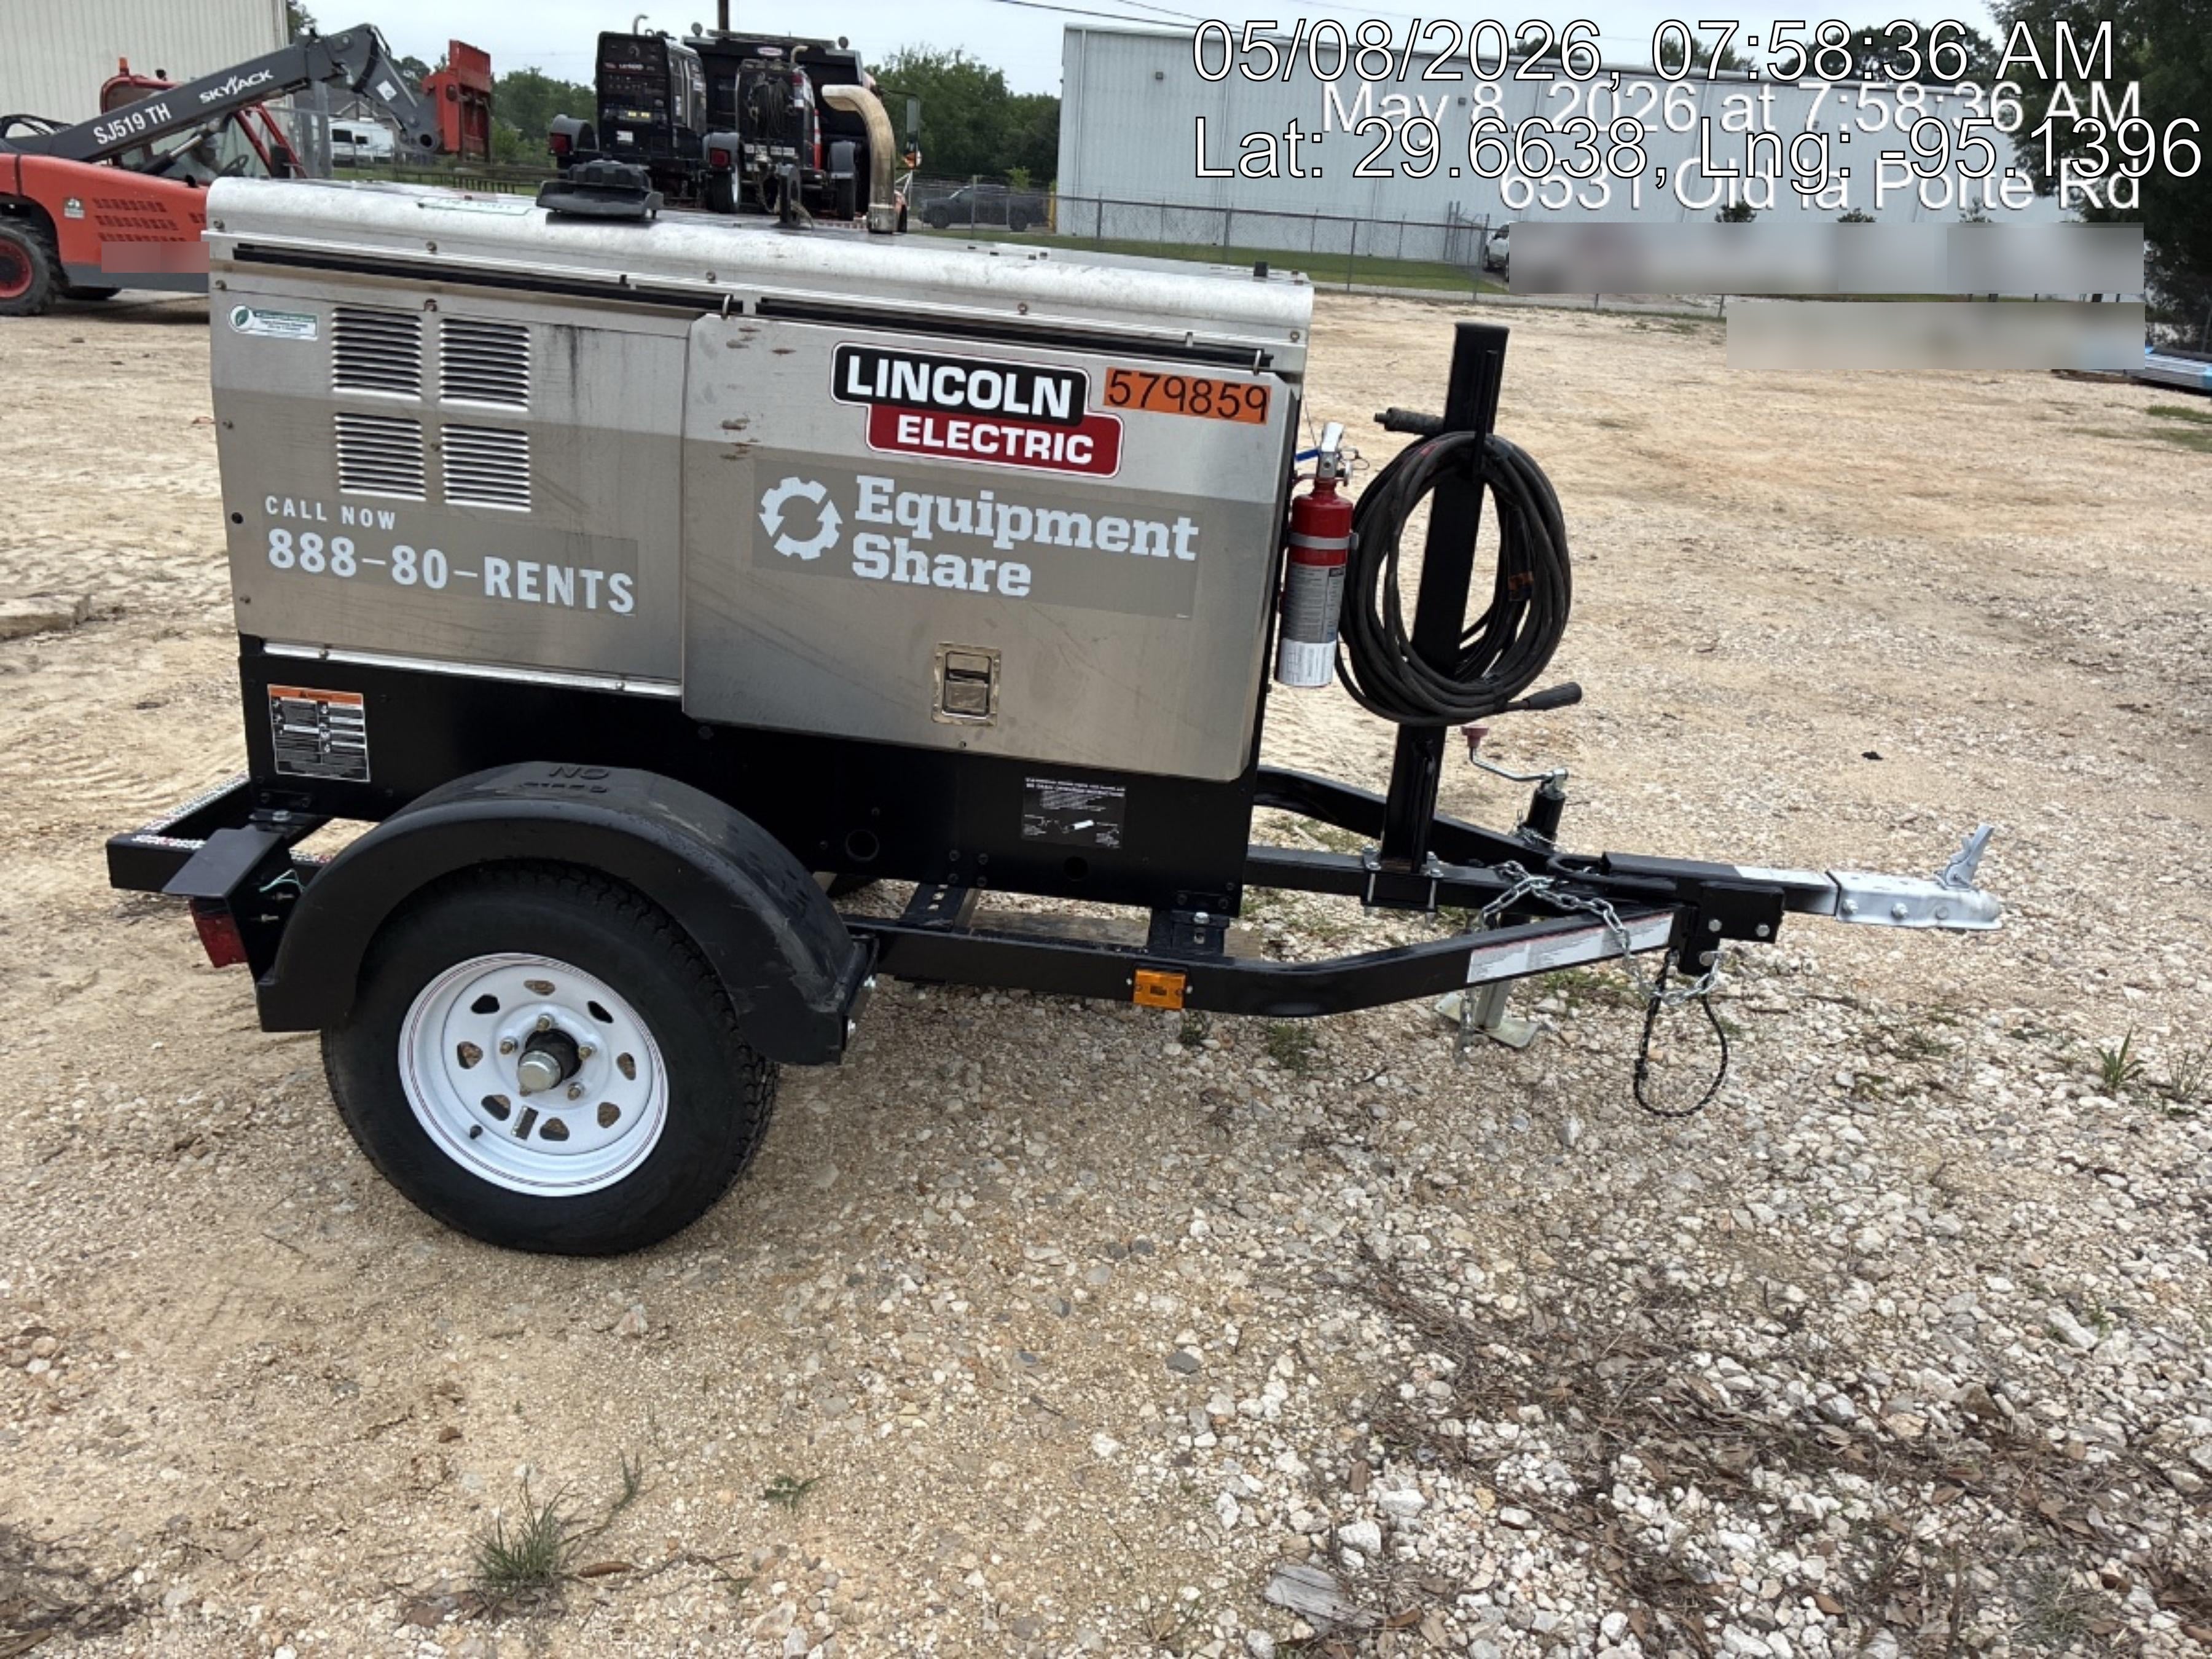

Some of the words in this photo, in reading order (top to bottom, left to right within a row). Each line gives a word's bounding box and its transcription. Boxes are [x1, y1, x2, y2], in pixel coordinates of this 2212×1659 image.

[199, 69, 274, 104] SKYJACK
[93, 111, 147, 144] SJ519
[145, 103, 172, 125] TH
[846, 355, 1072, 419] LINCOLN
[1107, 369, 1268, 423] 579859
[896, 414, 1094, 465] ELECTRIC
[265, 495, 327, 522] CALL
[340, 505, 396, 530] NOW
[854, 474, 1199, 560] Equipment
[268, 528, 635, 613] 888-80-RENTS
[852, 532, 1032, 597] Share
